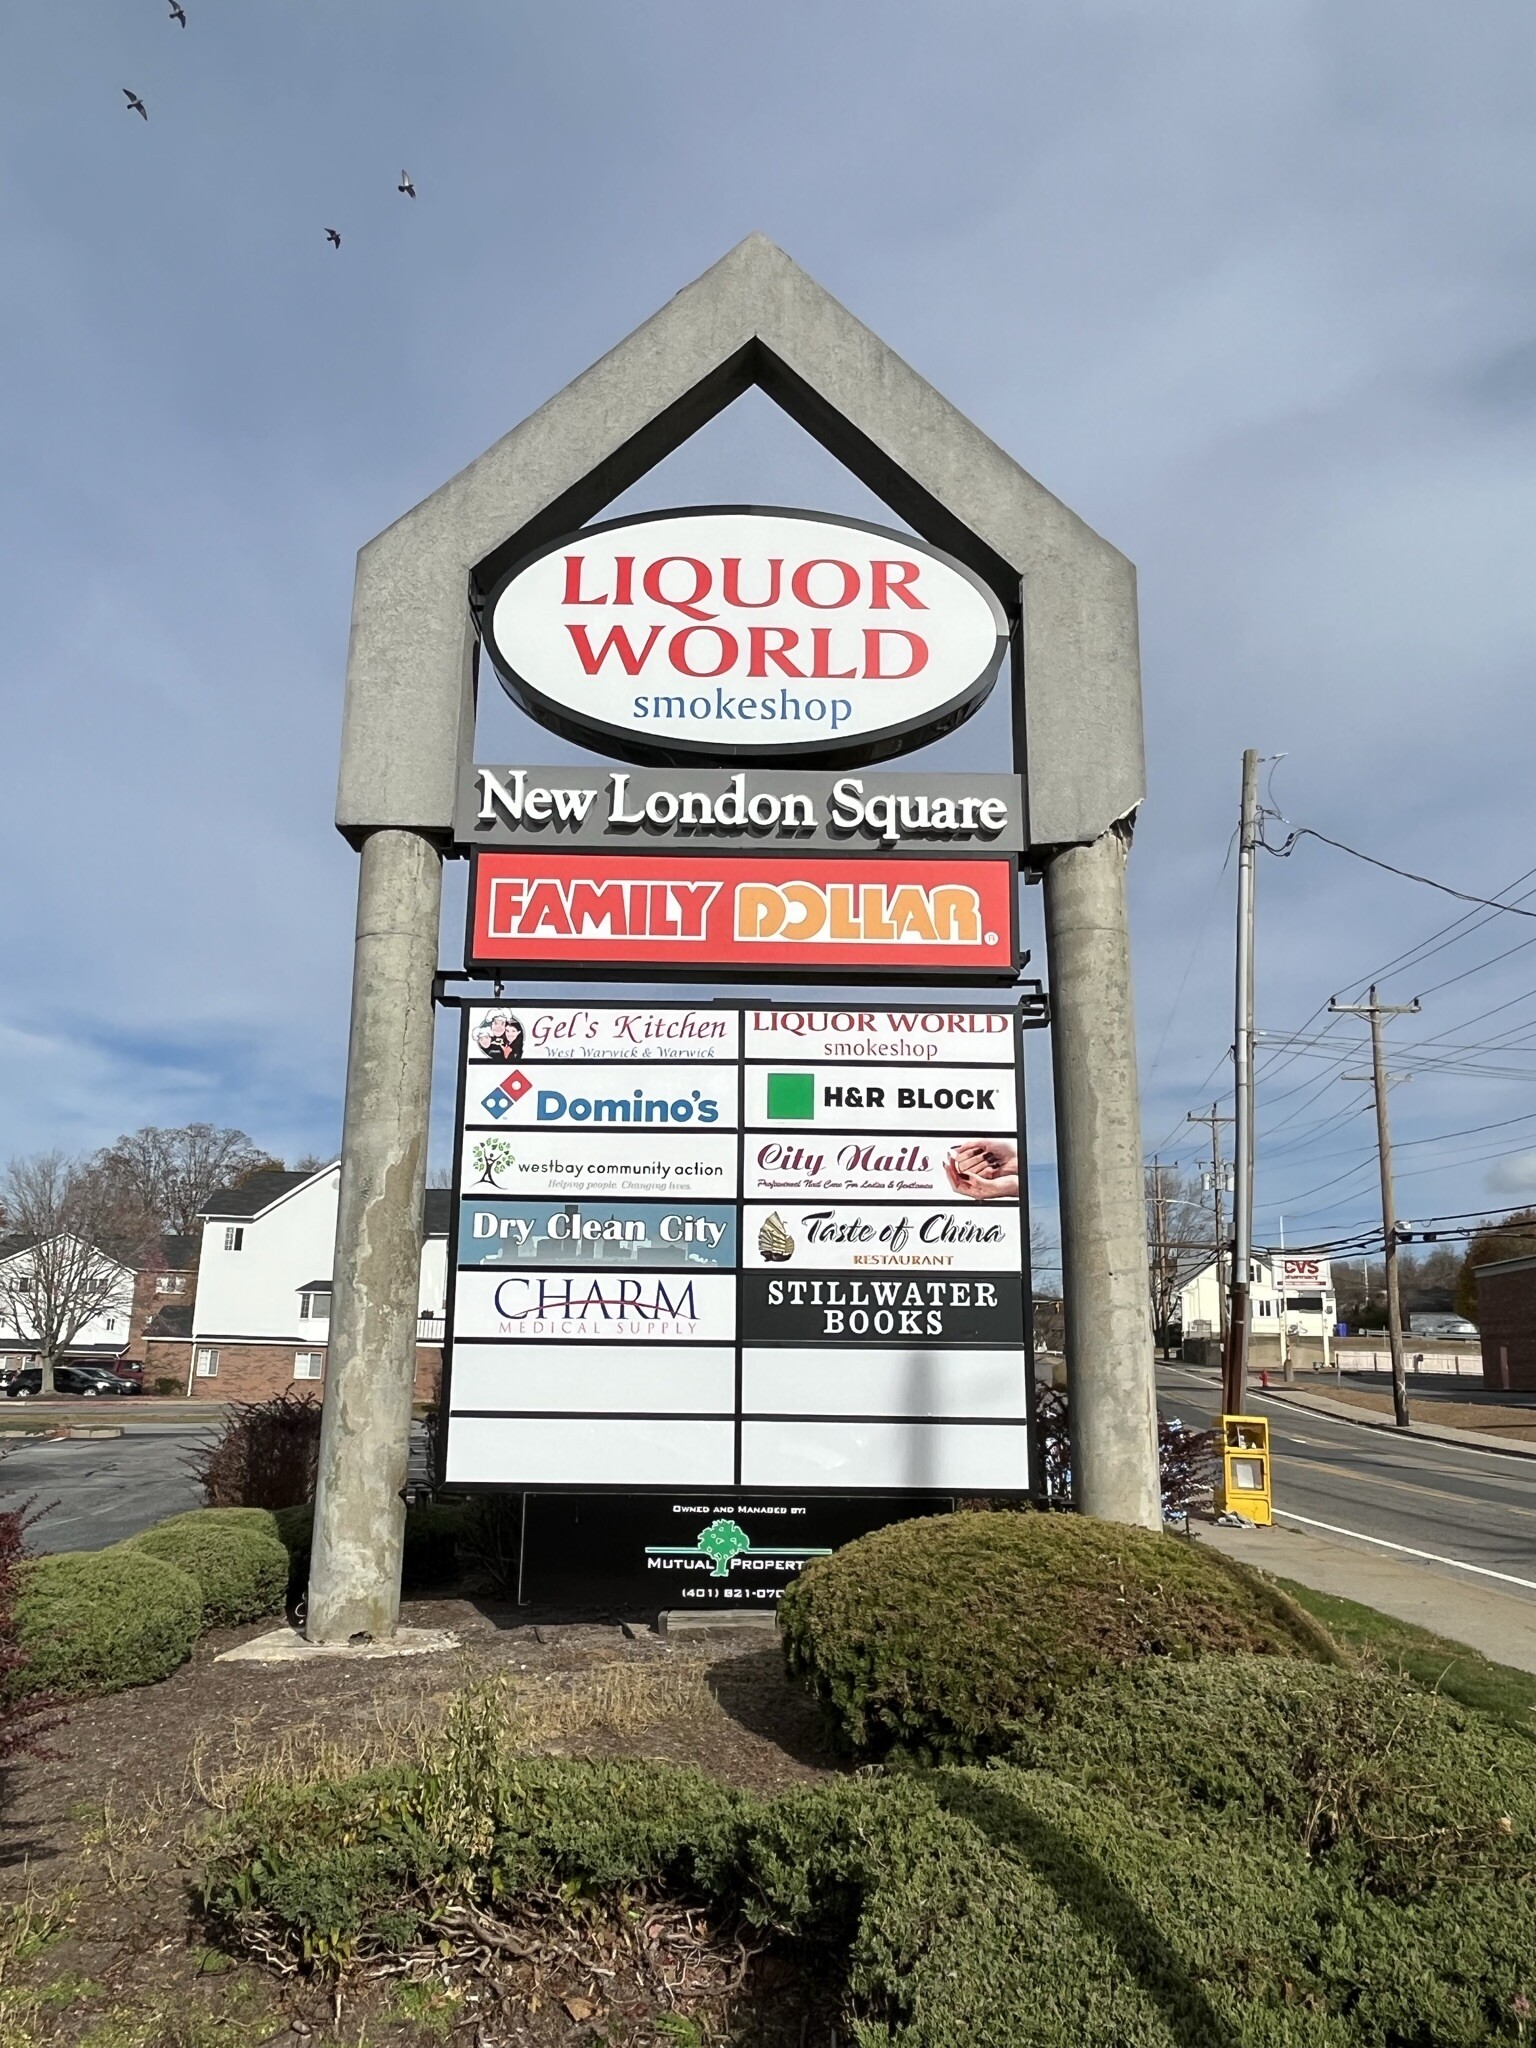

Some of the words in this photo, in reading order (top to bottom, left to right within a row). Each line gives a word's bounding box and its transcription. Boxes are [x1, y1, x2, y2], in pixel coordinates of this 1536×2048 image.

[561, 555, 931, 621] LIQUOR
[563, 623, 931, 680] WORLD
[632, 688, 853, 730] smokeshop
[476, 769, 598, 822] New
[608, 772, 818, 828] London
[831, 779, 1009, 840] Square
[488, 878, 724, 941] FAMILY
[733, 880, 982, 945] DOLLAR
[532, 1011, 599, 1047] Gel's
[614, 1011, 728, 1043] Kitchen
[753, 1011, 878, 1037] LIQUOR
[885, 1013, 1009, 1034] WORLD
[544, 1046, 575, 1059] West
[579, 1046, 639, 1059] Warwick
[642, 1048, 652, 1059] &
[656, 1046, 715, 1059] Warwick
[824, 1038, 938, 1061] smokeshop
[536, 1089, 719, 1123] Domino's
[824, 1086, 885, 1108] H&R
[898, 1088, 996, 1110] BLOCK
[517, 1159, 583, 1178] westbay
[587, 1160, 671, 1179] community
[674, 1161, 724, 1177] action
[756, 1142, 826, 1177] City
[836, 1144, 934, 1172] Nails
[548, 1180, 585, 1190] Helping
[621, 1181, 667, 1191] Changing
[472, 1211, 535, 1245] Dry
[547, 1212, 646, 1241] Clean
[659, 1214, 728, 1249] City
[801, 1209, 877, 1244] Taste
[878, 1215, 915, 1253] of
[919, 1213, 1006, 1245] China
[852, 1254, 955, 1266] RESTAURANT
[1284, 1260, 1319, 1274] CVS
[494, 1278, 702, 1321] CHARM
[767, 1280, 999, 1308] STILLWATER
[499, 1321, 601, 1334] MEDICAL
[617, 1322, 698, 1335] SUPPLY
[823, 1309, 944, 1335] BOOKS
[647, 1557, 716, 1570] MUTUAL
[730, 1558, 805, 1571] PROPERT
[681, 1588, 719, 1599] (401)
